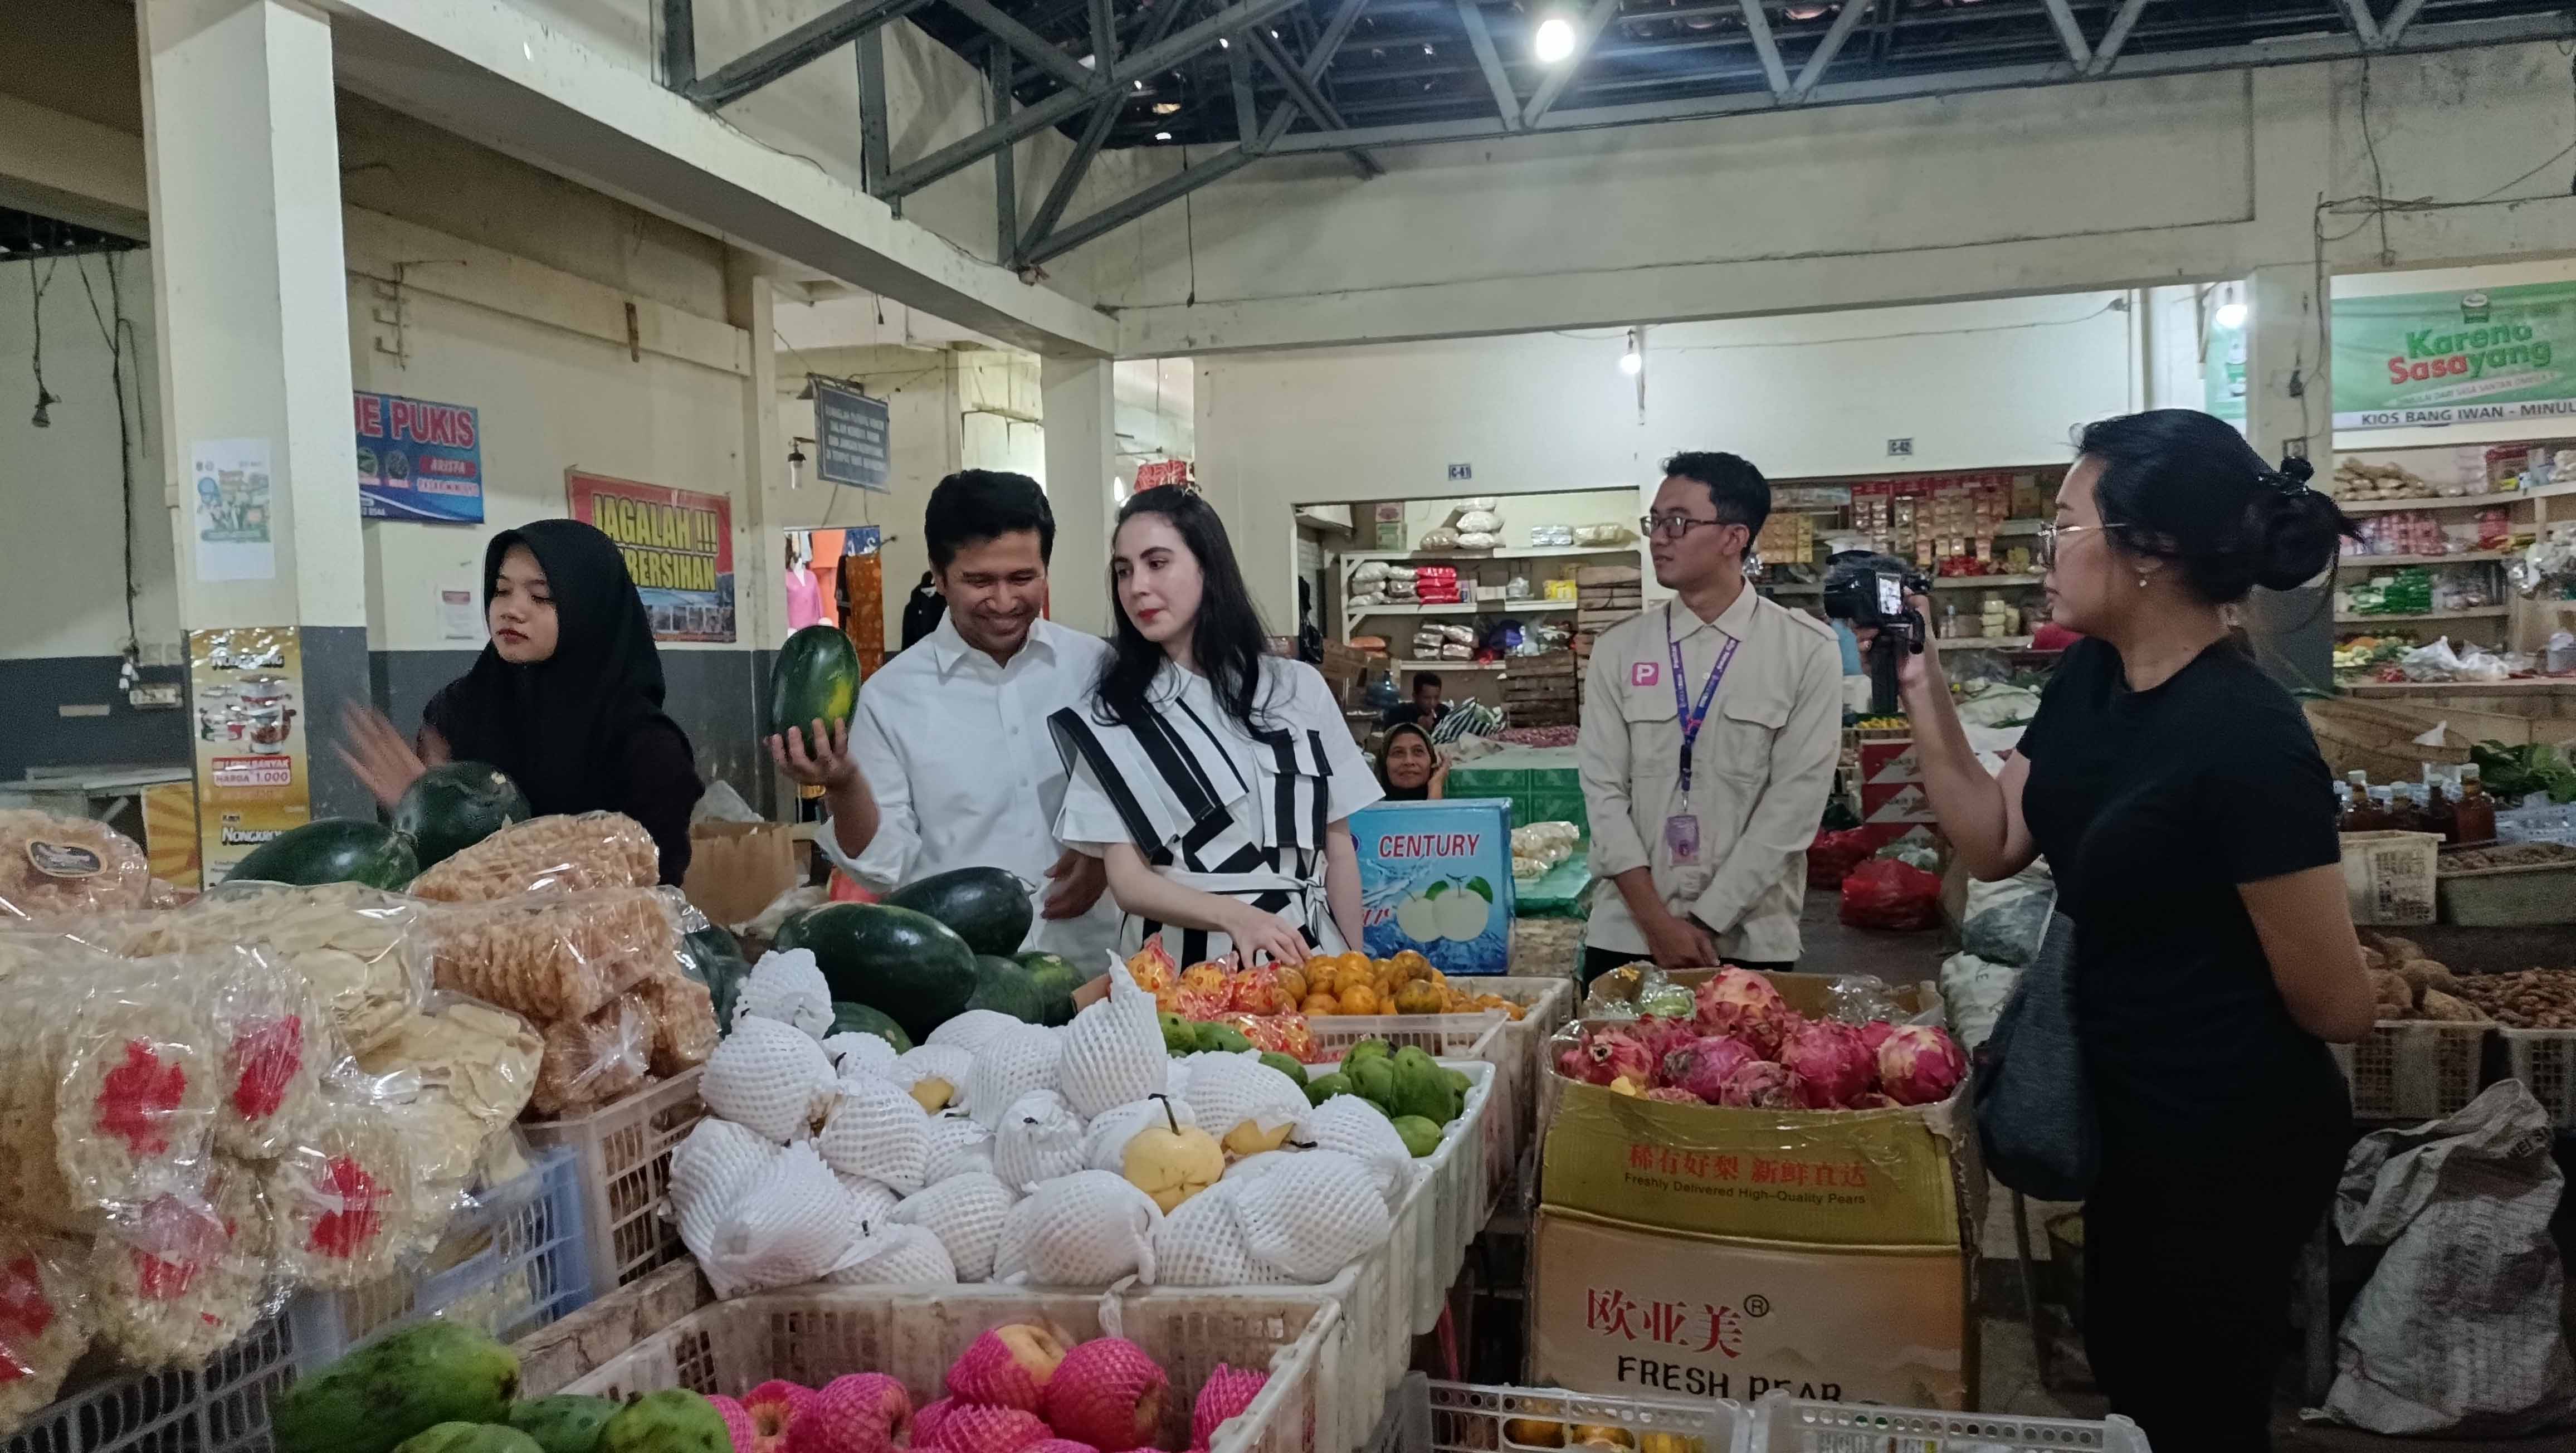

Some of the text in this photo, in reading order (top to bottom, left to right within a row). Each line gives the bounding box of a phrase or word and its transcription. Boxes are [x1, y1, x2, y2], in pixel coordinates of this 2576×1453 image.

[2388, 340, 2551, 384] Sasayang
[391, 399, 475, 448] PUKIS
[2362, 412, 2399, 426] KIOS
[2406, 409, 2451, 423] BANG
[2458, 406, 2503, 420] IWAN
[593, 494, 692, 551] JAGALAH
[621, 547, 717, 592] BERSIHAN
[1379, 835, 1480, 858] CENTURY
[1625, 1172, 1668, 1191] Freshly
[1674, 1181, 1734, 1196] Delivered
[1828, 1194, 1865, 1204] Pears
[1586, 1288, 1743, 1358] 欧亚美
[1617, 1355, 1842, 1402] FRESH PAR
